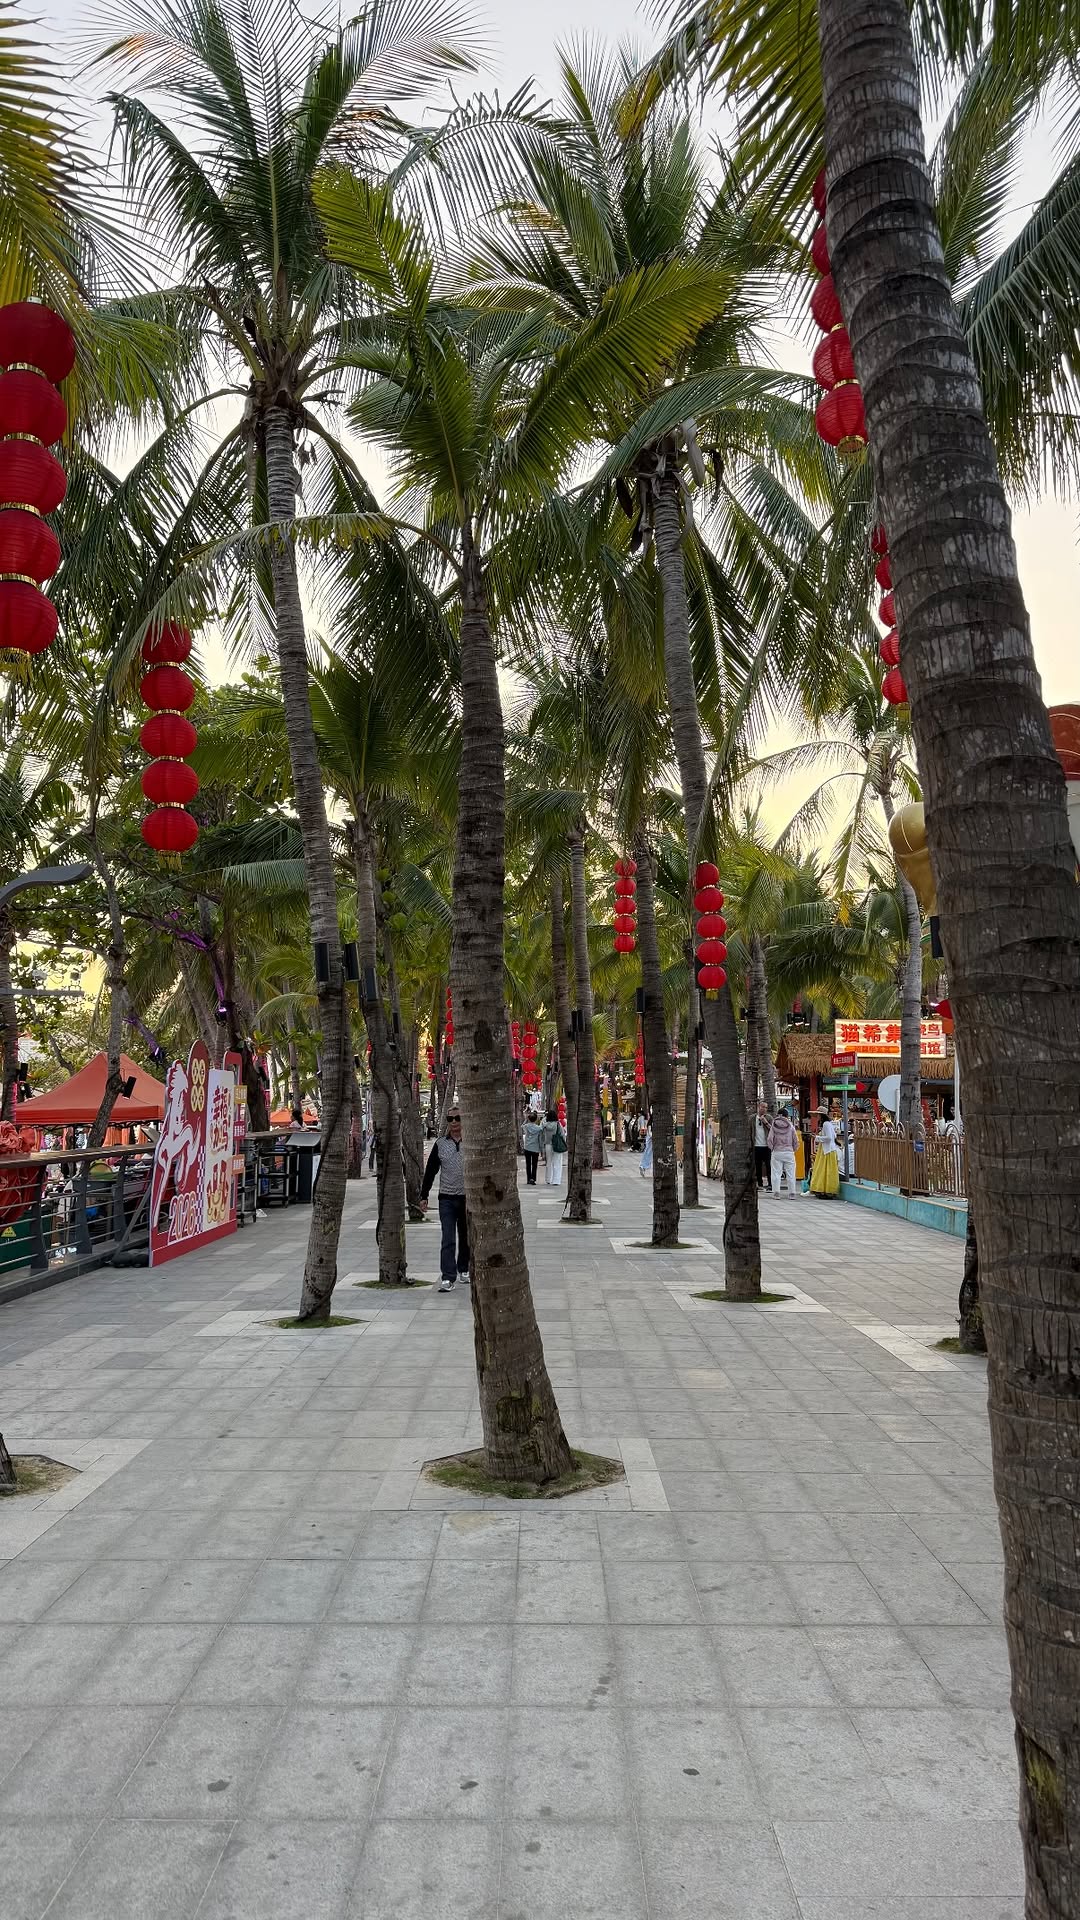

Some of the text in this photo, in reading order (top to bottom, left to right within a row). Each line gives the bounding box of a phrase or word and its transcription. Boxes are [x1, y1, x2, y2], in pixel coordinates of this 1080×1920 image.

[841, 1024, 901, 1043] 猫希集
[168, 1191, 197, 1244] 2026
